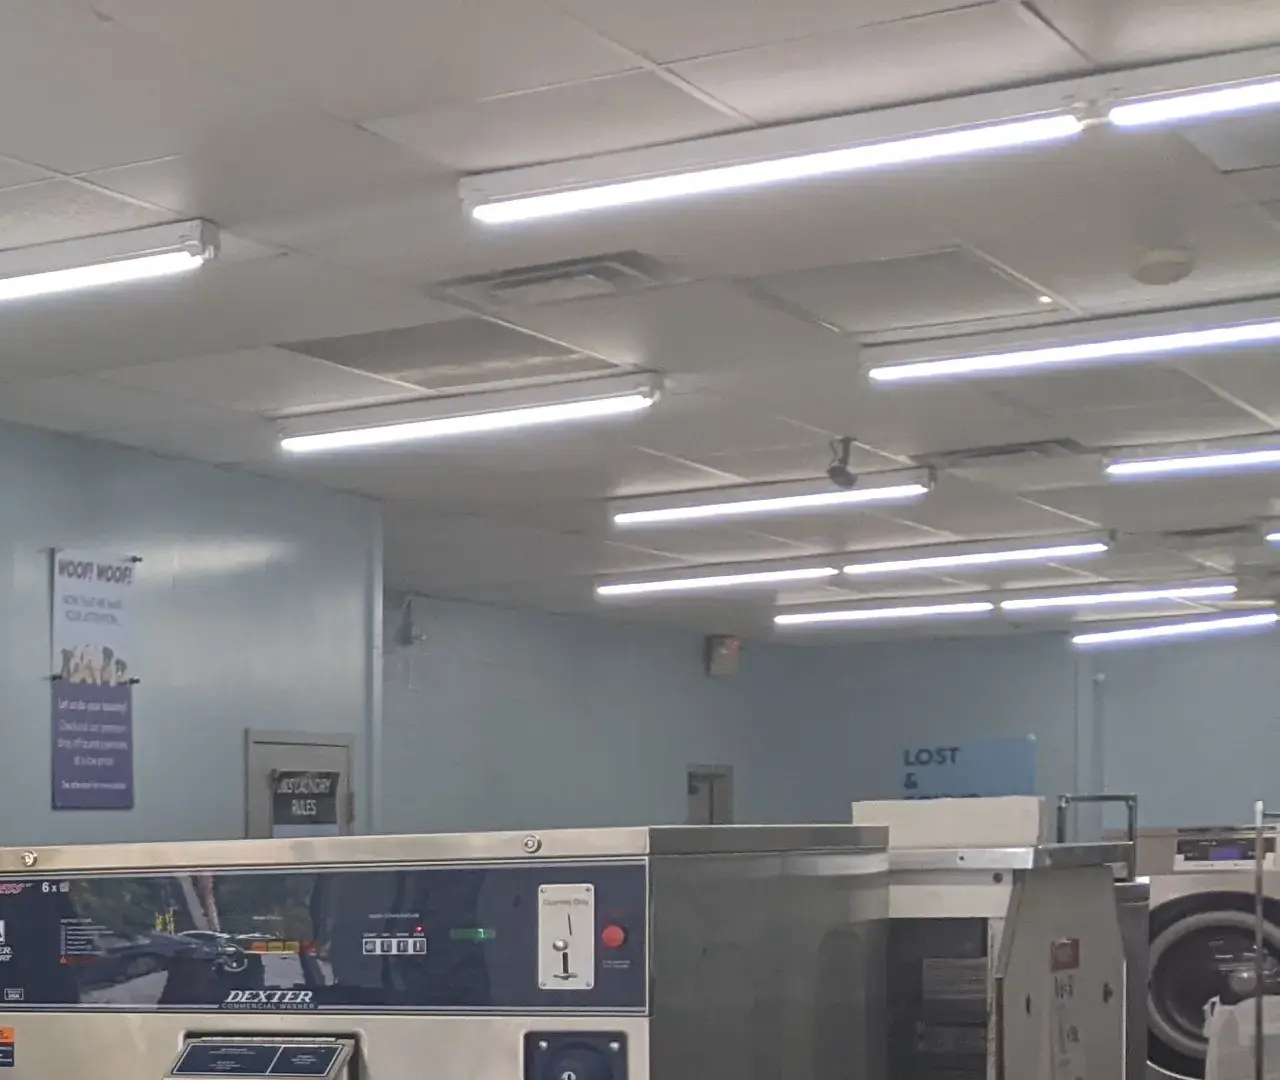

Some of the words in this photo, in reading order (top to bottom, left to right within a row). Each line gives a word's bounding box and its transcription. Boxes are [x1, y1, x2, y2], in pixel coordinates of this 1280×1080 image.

[903, 746, 960, 766] LOST
[904, 772, 918, 790] &
[292, 799, 317, 815] RULES
[42, 882, 50, 893] 6
[225, 990, 314, 1003] DEXTER
